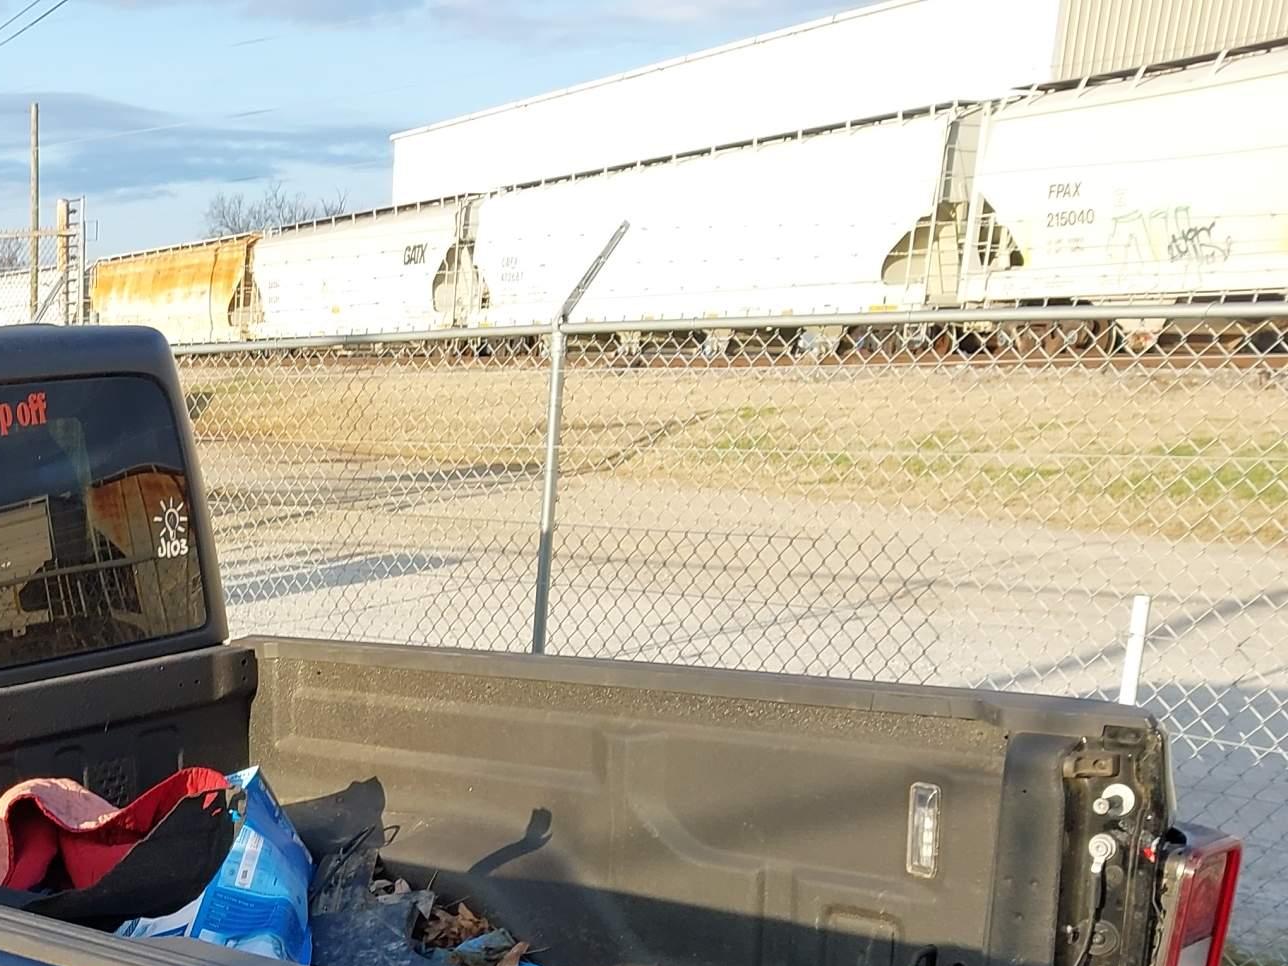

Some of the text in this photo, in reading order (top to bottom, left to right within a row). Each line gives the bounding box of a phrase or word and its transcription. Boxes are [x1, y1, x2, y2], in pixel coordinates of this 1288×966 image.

[1048, 182, 1082, 199] FPAX
[1047, 208, 1095, 228] 215040
[403, 242, 428, 265] GATX
[16, 391, 48, 427] off
